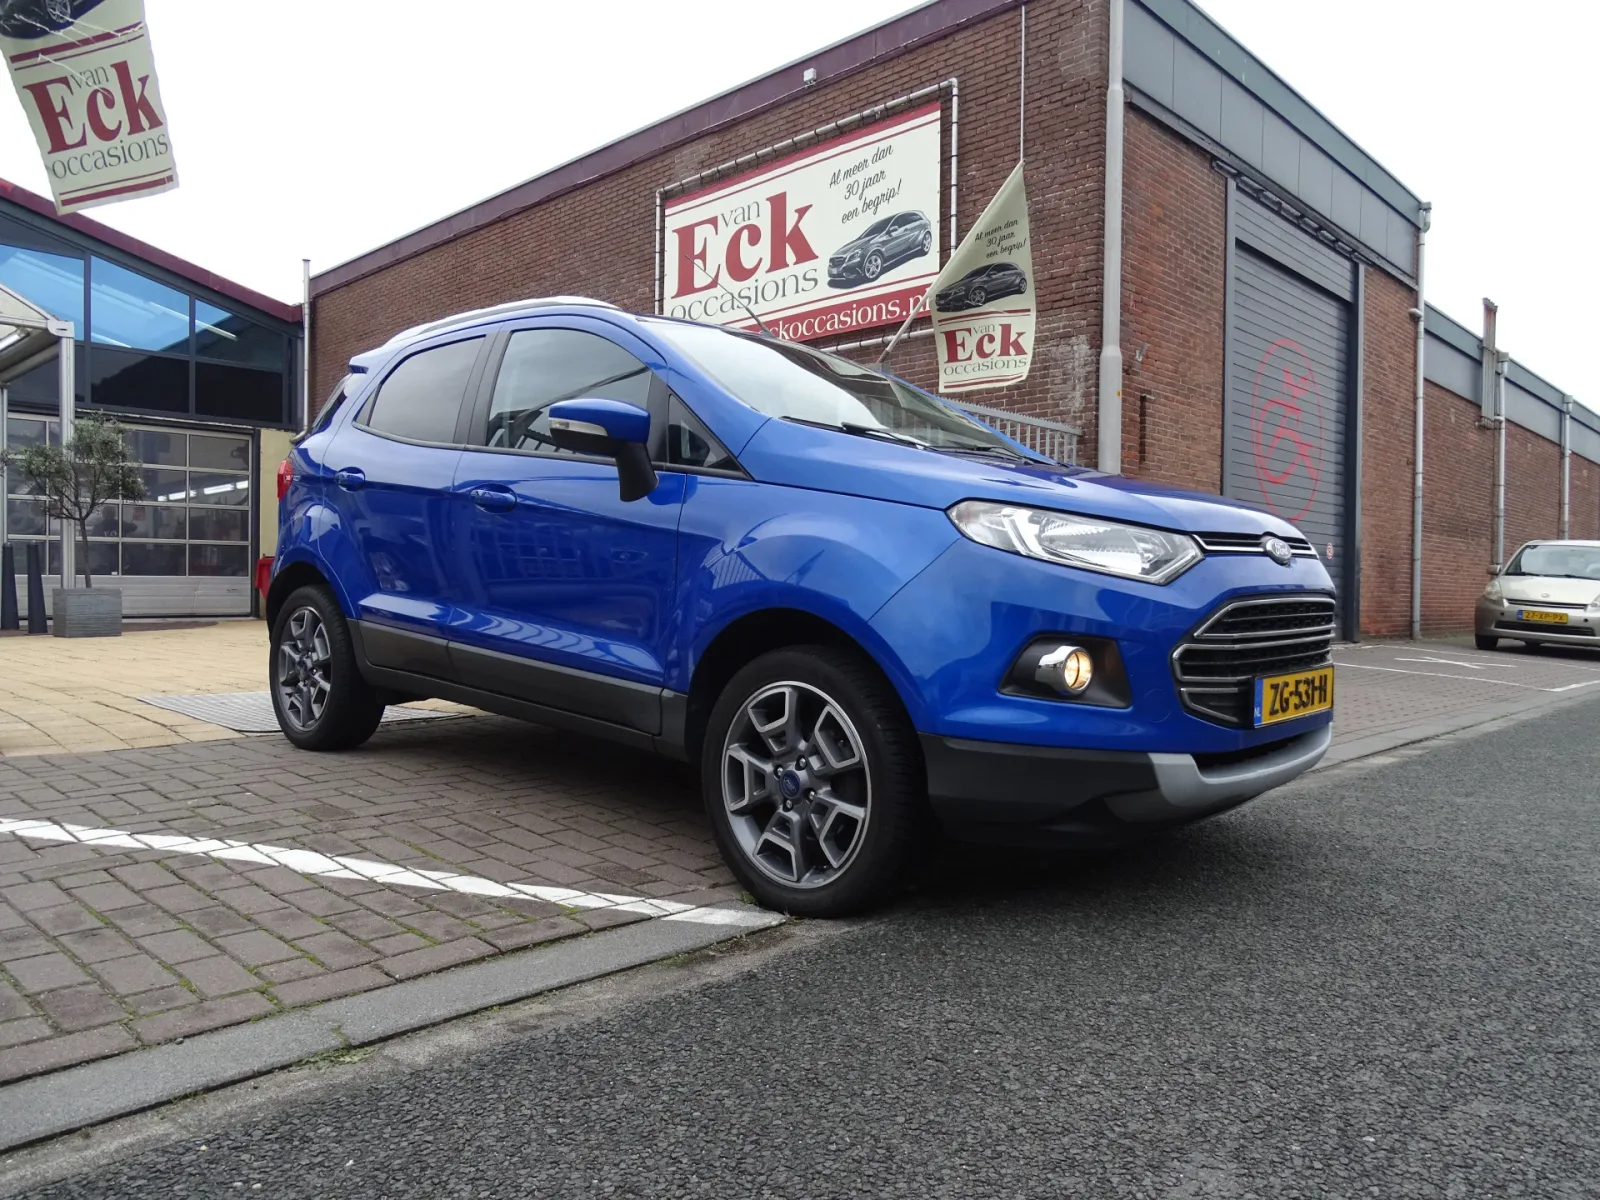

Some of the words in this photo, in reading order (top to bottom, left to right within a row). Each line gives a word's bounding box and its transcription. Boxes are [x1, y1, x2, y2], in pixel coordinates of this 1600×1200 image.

[70, 66, 110, 89] van
[22, 60, 164, 154] Eck
[52, 133, 168, 180] occasions
[829, 168, 842, 189] Al
[843, 158, 870, 181] meer
[871, 144, 894, 165] dan
[841, 207, 860, 224] een
[861, 177, 902, 216] begrip!
[844, 179, 859, 200] 30
[859, 169, 887, 201] jaar
[721, 201, 761, 228] van
[975, 231, 984, 242] Al
[984, 226, 1002, 238] meer
[1003, 219, 1018, 229] dan
[671, 191, 819, 299] Eck
[986, 236, 997, 247] 30
[997, 232, 1015, 247] jaar
[986, 250, 998, 259] een
[1000, 237, 1027, 255] begrip!
[670, 267, 819, 321] occasions
[940, 323, 1029, 364] Eck
[973, 324, 996, 335] van
[944, 357, 1027, 376] occasions
